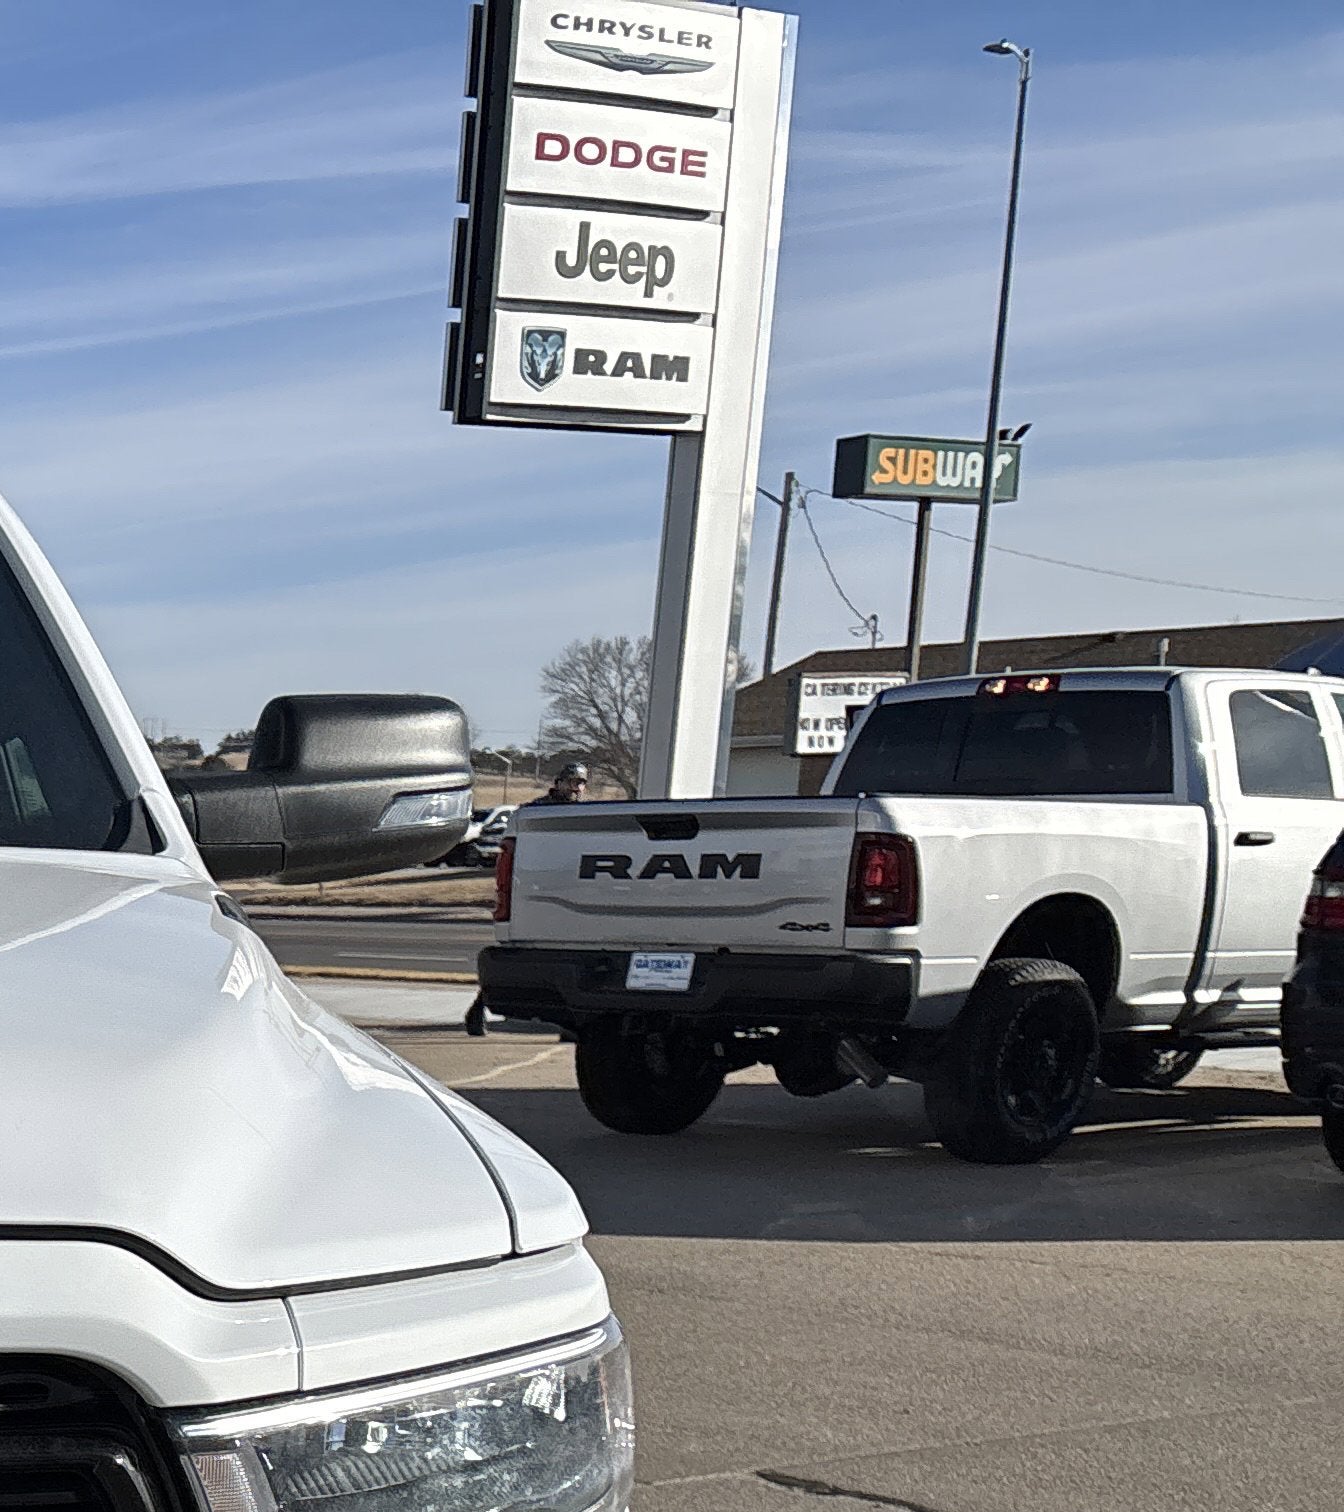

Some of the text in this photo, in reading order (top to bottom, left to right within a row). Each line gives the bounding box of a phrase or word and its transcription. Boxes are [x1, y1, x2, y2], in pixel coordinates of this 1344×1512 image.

[550, 13, 714, 50] CHRYSLER
[535, 132, 709, 178] DODGE
[554, 221, 676, 298] Jeep
[572, 348, 691, 382] RAM
[578, 853, 763, 880] RAM
